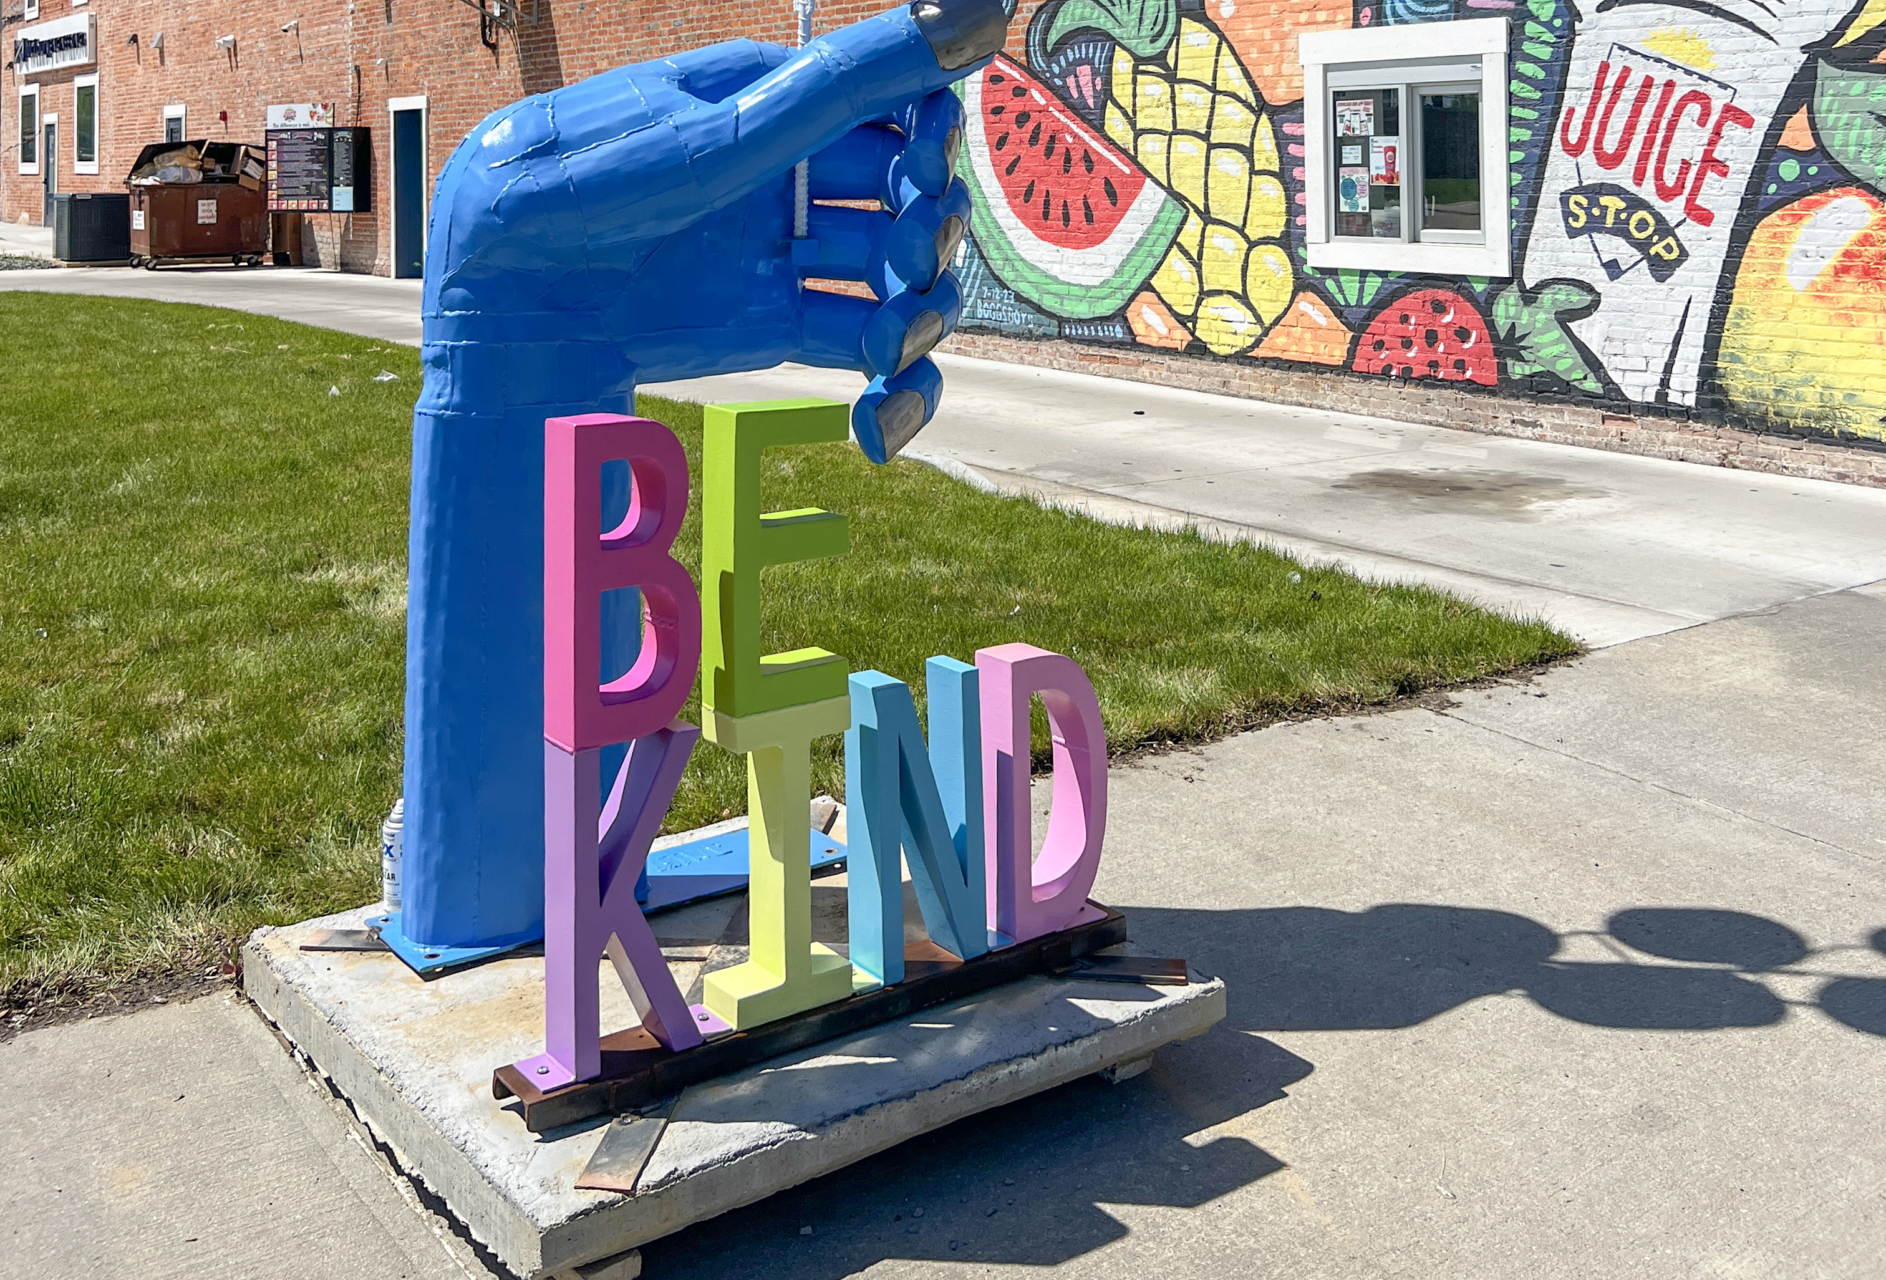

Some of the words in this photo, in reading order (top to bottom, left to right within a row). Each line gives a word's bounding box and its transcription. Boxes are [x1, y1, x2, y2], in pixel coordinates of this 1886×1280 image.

[1560, 61, 1755, 227] JUICE
[544, 402, 850, 751] BE
[544, 644, 1106, 1081] KIND
